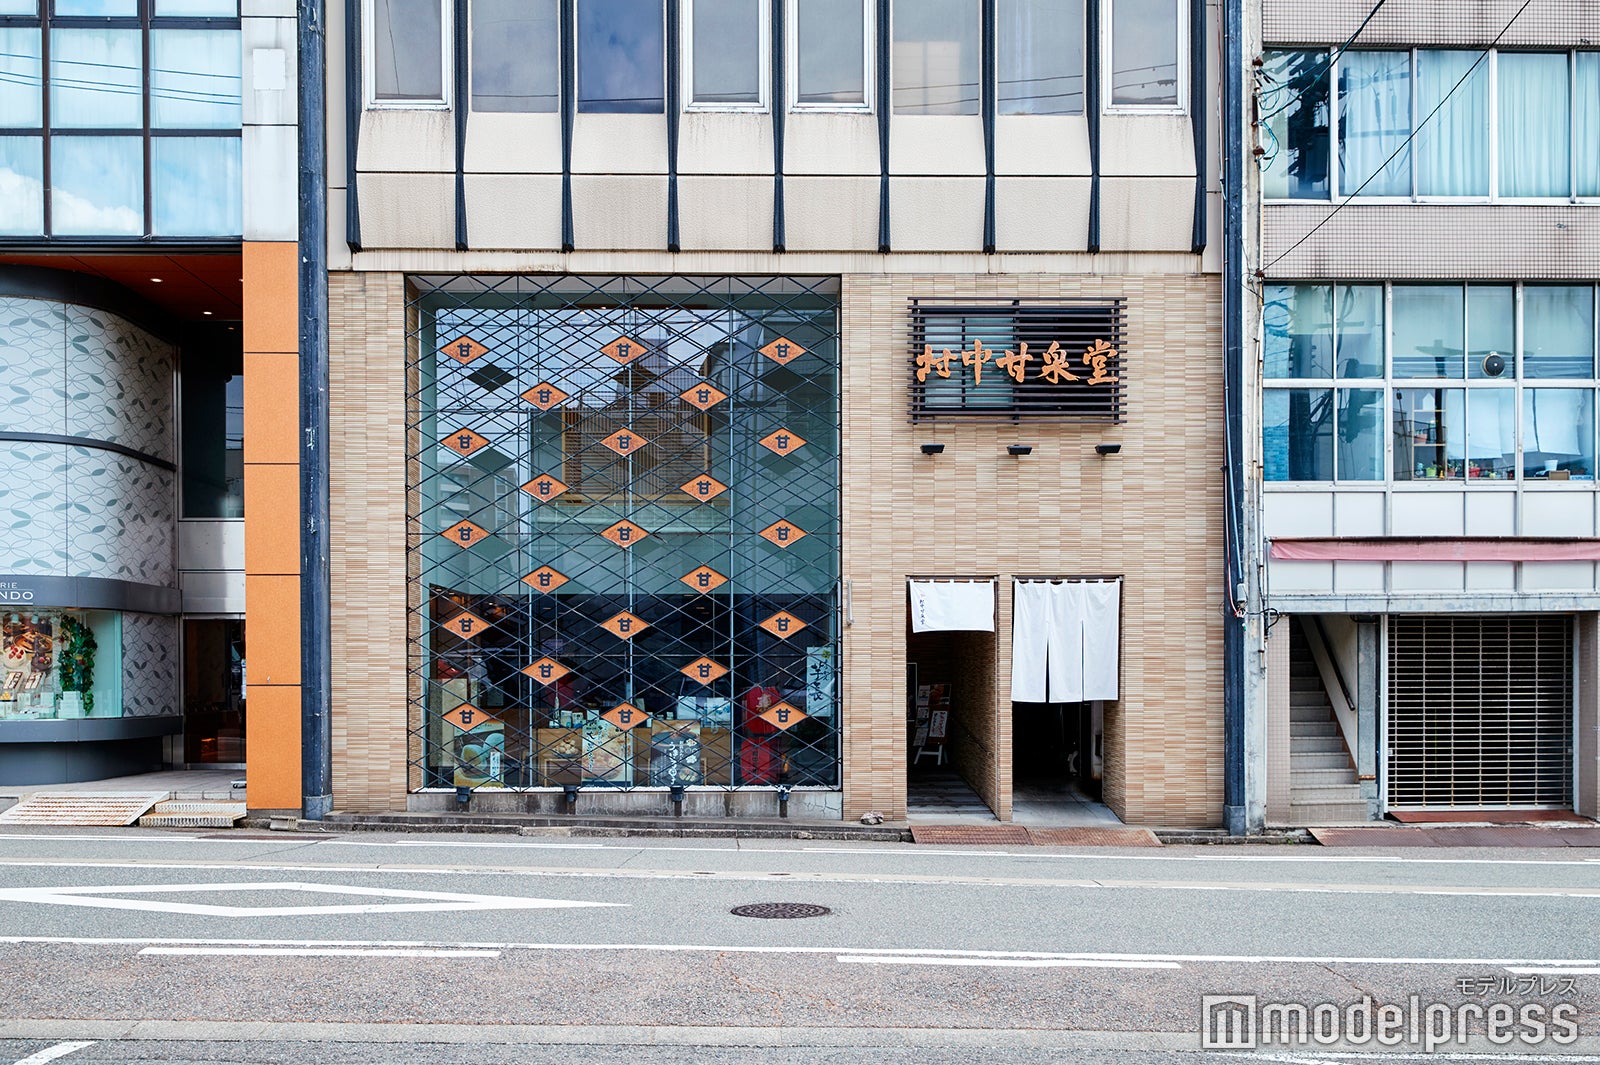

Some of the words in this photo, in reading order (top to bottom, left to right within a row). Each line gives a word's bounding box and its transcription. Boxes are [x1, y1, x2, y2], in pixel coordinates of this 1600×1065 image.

[916, 339, 1119, 385] 村中甘泉堂
